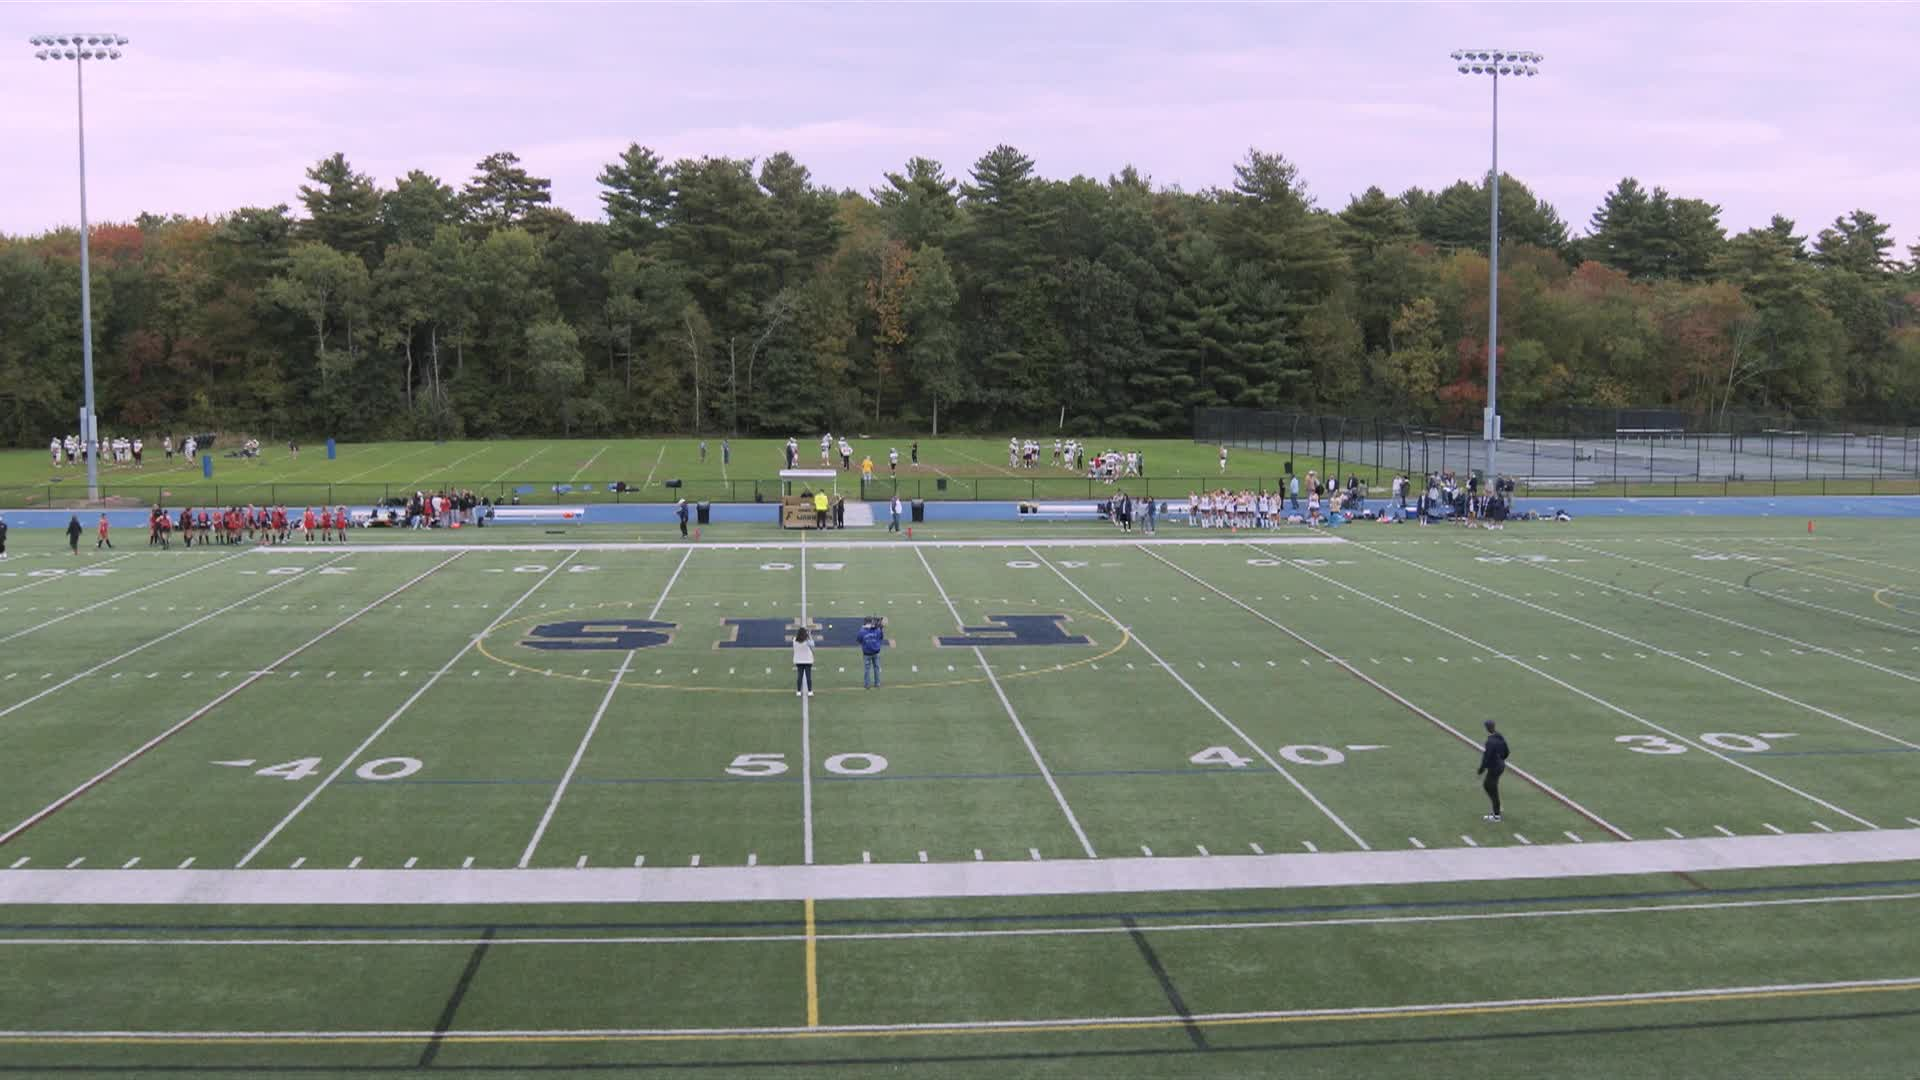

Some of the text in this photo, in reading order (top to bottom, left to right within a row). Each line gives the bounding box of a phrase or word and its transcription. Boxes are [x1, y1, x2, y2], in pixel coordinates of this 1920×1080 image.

[1615, 732, 1770, 754] 30
[725, 753, 888, 776] 50
[1190, 745, 1344, 767] 40
[256, 757, 422, 781] 40
